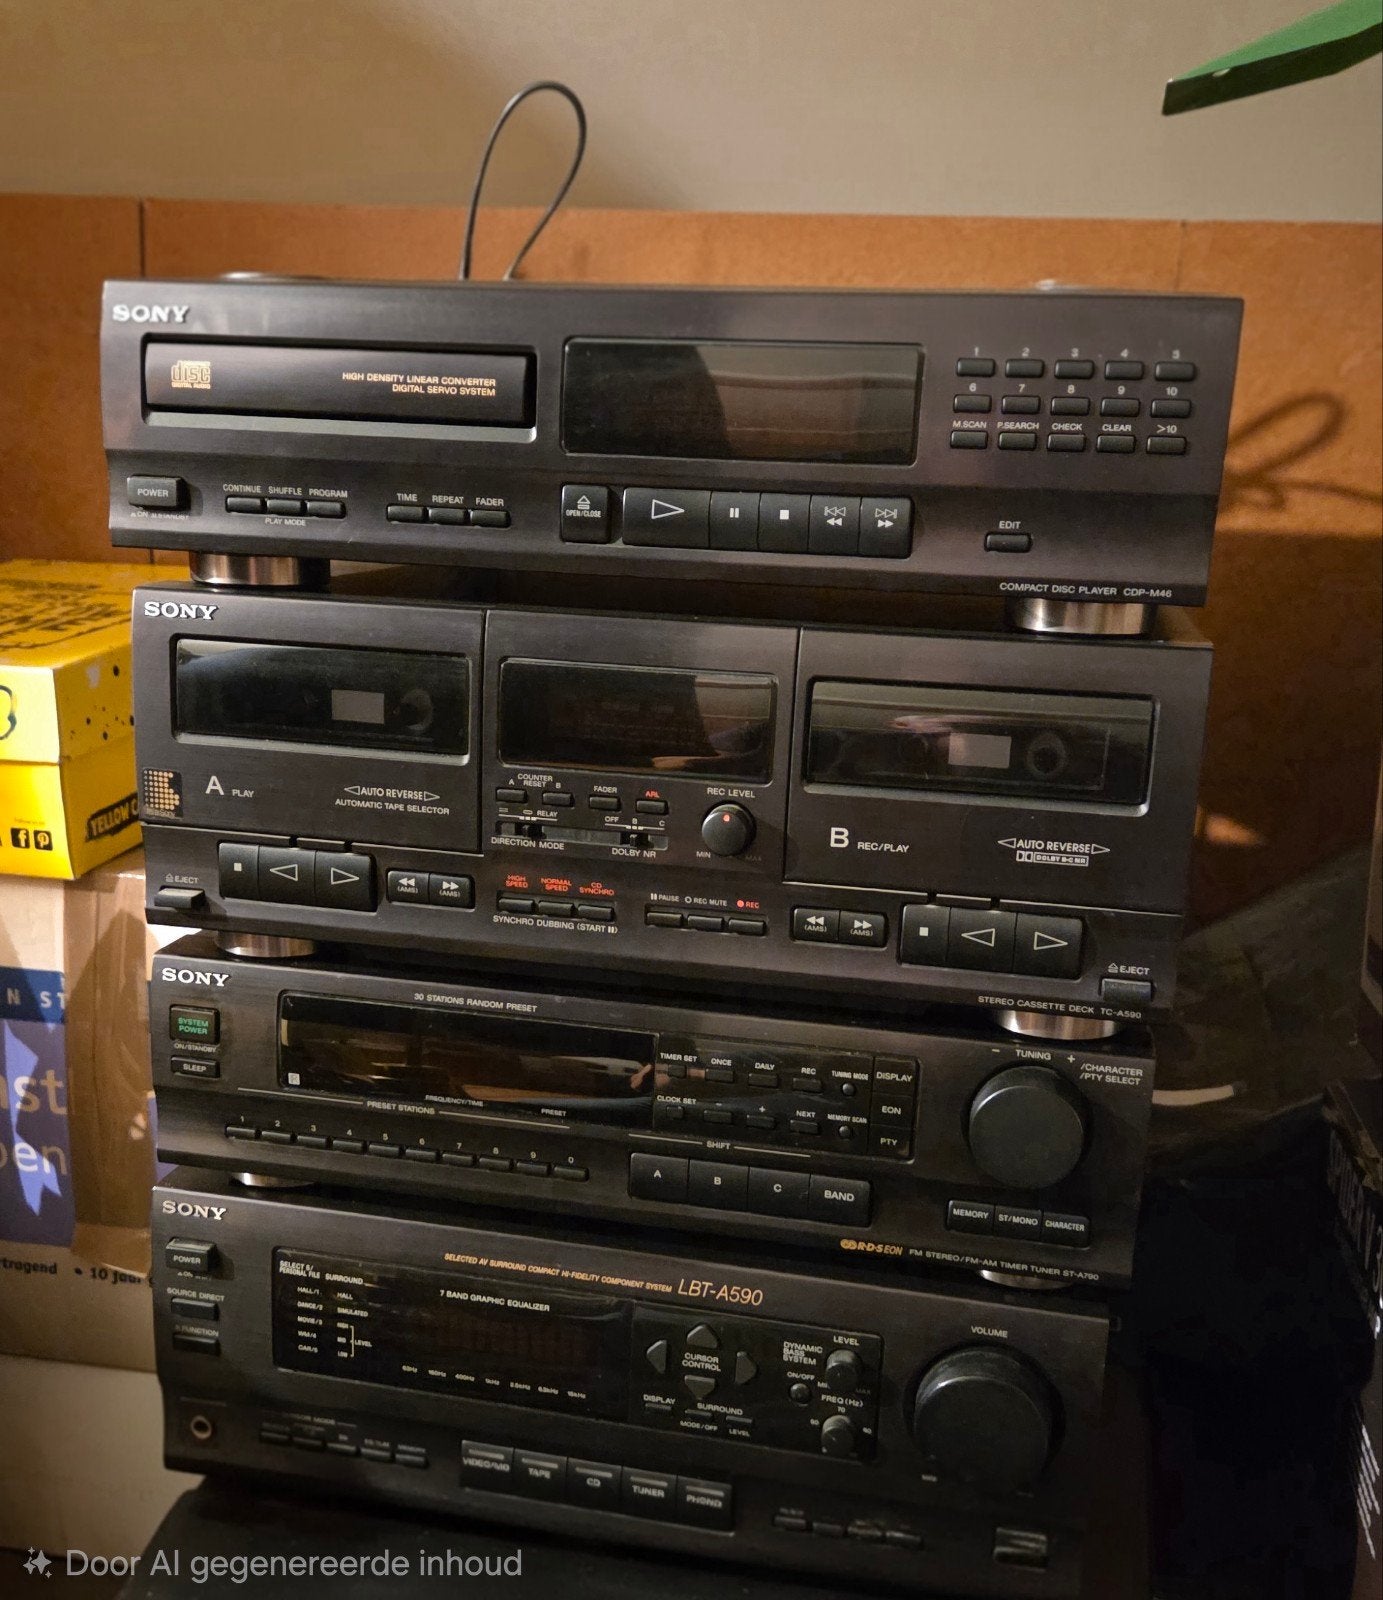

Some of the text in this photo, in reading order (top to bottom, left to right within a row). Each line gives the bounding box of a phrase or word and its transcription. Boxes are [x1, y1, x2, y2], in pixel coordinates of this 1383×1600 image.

[112, 304, 189, 323] SONY
[1022, 347, 1030, 357] 2
[342, 372, 496, 387] HIGH DENSITY LINEAR CONVERTER
[392, 384, 496, 396] DIGITAL SERVO SYSTEM
[1019, 384, 1178, 396] 7 10
[952, 421, 1177, 434] M.SCAN P.SEARCH CHECK CLEAR >10
[137, 488, 169, 498] POWER
[222, 484, 347, 498] CONTINUE SHUFFLE PROGRAM
[396, 493, 602, 518] TIME REPEAT FADER OPEN/CLOSE
[264, 517, 306, 526] PLAY MODE
[999, 520, 1021, 530] EDIT
[1000, 582, 1172, 598] COMPACT DISC PLAYER CDP-M46
[144, 601, 218, 620] SONY
[517, 773, 553, 782] COUNTER
[206, 775, 255, 798] A PLAY
[523, 780, 547, 788] RESET
[594, 785, 617, 793] FADER
[360, 786, 423, 801] AUTO REVERSE
[707, 787, 756, 799] REC LEVEL
[335, 798, 449, 815] AUTOMATIC TAPE SELECTOR
[91, 802, 129, 836] YELLOW
[537, 809, 558, 818] RELAY
[490, 837, 565, 850] DIRECTION MODE
[830, 827, 910, 854] B REC/PLAY
[1017, 839, 1091, 854] AUTO REVERSE
[612, 848, 657, 858] DOLBY NR
[174, 875, 199, 884] EJECT
[579, 887, 615, 896] SYNCHRO
[659, 894, 679, 902] PAUSE
[709, 898, 728, 907] MUTE
[493, 915, 606, 933] SYNCHRO DUBBING (START
[1119, 965, 1150, 975] EJECT
[161, 967, 229, 987] SONY
[7, 988, 21, 1004] N
[414, 993, 537, 1013] 30 STATIONS RANDOM PRESET
[978, 995, 1142, 1019] STEREO CASSETTE DECK TC-A590
[178, 1017, 209, 1027] SYSTEM
[178, 1024, 208, 1035] POWER
[173, 1042, 217, 1053] ON/STANDBY
[660, 1052, 682, 1061] TIMER
[1016, 1050, 1052, 1061] TUNING
[182, 1063, 207, 1072] SLEEP
[711, 1058, 732, 1067] ONCE
[754, 1062, 775, 1071] DAILY
[801, 1067, 816, 1075] REC
[1080, 1063, 1143, 1077] /CHARACTER
[876, 1071, 913, 1083] DISPLAY
[1105, 1074, 1141, 1086] SELECT
[657, 1095, 680, 1103] CLOCK
[367, 1100, 435, 1115] PRESET STATIONS
[541, 1107, 567, 1117] PRESET
[882, 1105, 901, 1115] EON
[796, 1110, 816, 1118] NEXT
[707, 1140, 731, 1150] SHIFT
[880, 1137, 897, 1146] PTY
[653, 1169, 855, 1202] A B C BAND
[162, 1200, 227, 1220] SONY
[953, 1207, 1085, 1232] MEMORY ST/MONO CHARACTER
[173, 1255, 201, 1264] POWER
[909, 1249, 923, 1257] FM
[1000, 1261, 1028, 1271] TIMER
[1030, 1265, 1060, 1276] TUNER
[90, 1267, 108, 1280] 10
[325, 1273, 363, 1285] SURROUND
[444, 1253, 763, 1306] SELECTED AV SURROUND COMPACT COMPONENT SYSTEM LBT-A590
[166, 1287, 225, 1302] SOURCE DIRECT
[446, 1291, 469, 1301] BAND
[470, 1294, 505, 1306] GRAPHIC
[507, 1299, 550, 1312] EQUALIZER
[971, 1325, 1008, 1339] VOLUME
[833, 1335, 860, 1346] LEVEL
[783, 1341, 823, 1354] DYNAMIC
[684, 1352, 719, 1363] CURSOR
[783, 1354, 816, 1366] SYSTEM
[682, 1360, 721, 1372] CONTROL
[786, 1371, 815, 1381] ON/OFF
[643, 1394, 676, 1405] DISPLAY
[821, 1394, 843, 1405] FREQ
[697, 1402, 743, 1416] SURROUND
[729, 1428, 750, 1437] LEVEL
[528, 1467, 551, 1479] TAPE
[586, 1477, 601, 1488] CD
[632, 1484, 665, 1498] TUNER
[686, 1494, 722, 1508] PHONO
